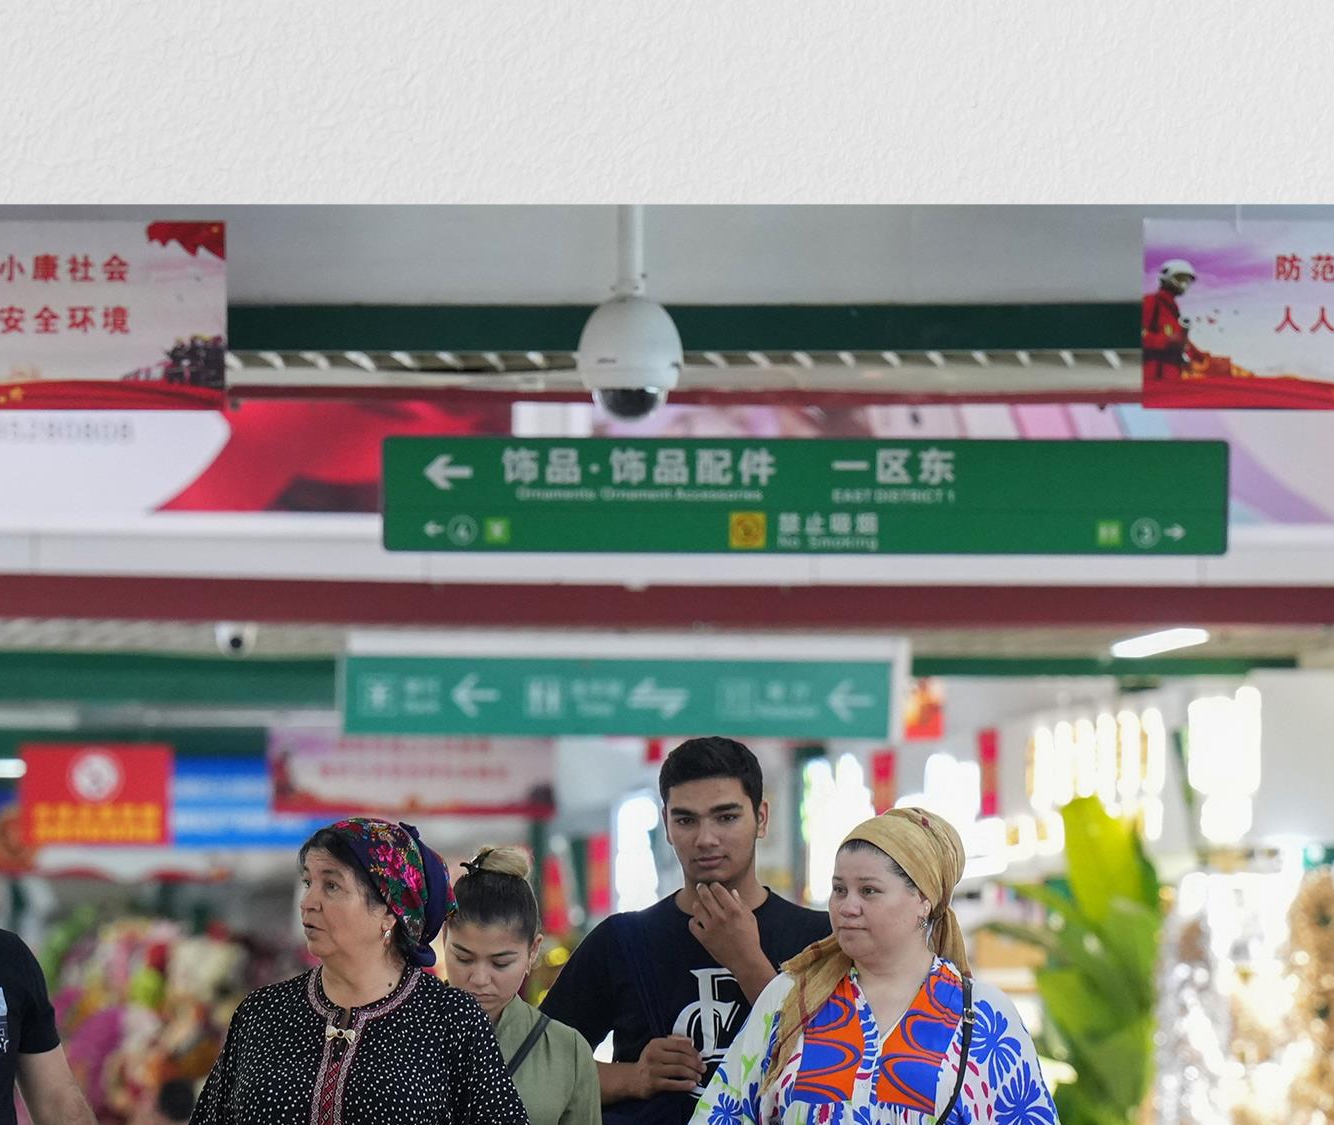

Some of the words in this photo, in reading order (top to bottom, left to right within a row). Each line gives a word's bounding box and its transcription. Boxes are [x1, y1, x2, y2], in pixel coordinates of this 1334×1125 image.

[501, 447, 776, 486] 饰品·饰品配件
[831, 446, 956, 485] 一区东
[778, 511, 878, 536] 禁止吸烟
[777, 537, 801, 549] No
[810, 536, 879, 552] Smoking
